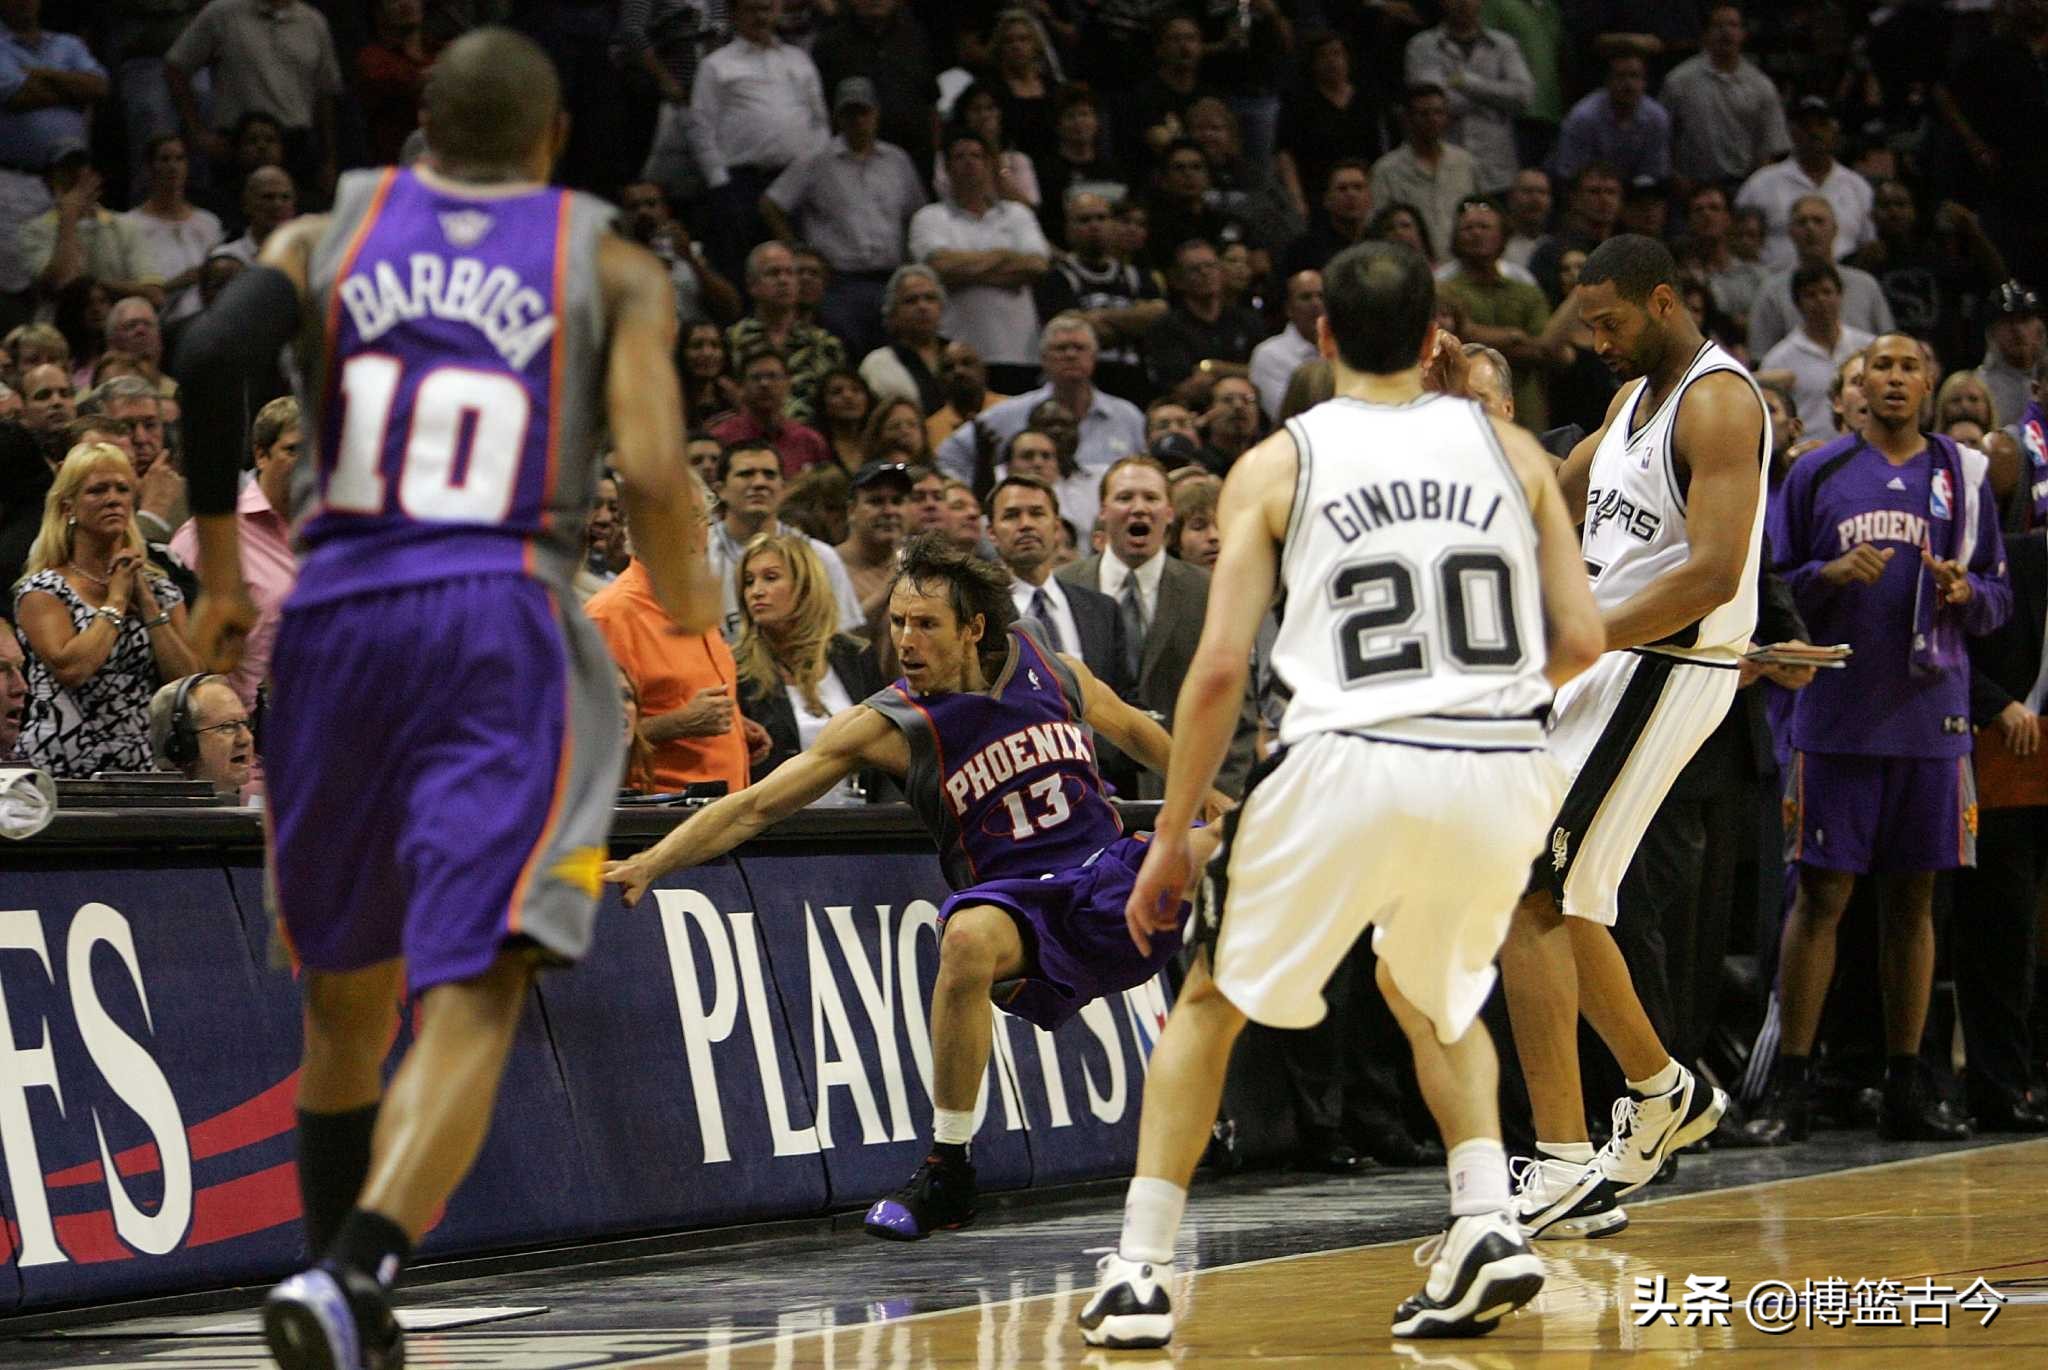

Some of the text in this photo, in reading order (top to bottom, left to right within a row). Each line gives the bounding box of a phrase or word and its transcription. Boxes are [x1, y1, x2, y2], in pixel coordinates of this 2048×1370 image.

[339, 253, 557, 370] BARBOSA
[326, 353, 530, 525] 10
[1322, 479, 1502, 544] GINOBILI
[1328, 547, 1529, 690] 20
[945, 722, 1091, 817] PHOENIX
[1002, 772, 1071, 841] 13
[652, 888, 1128, 1163] PLAYOS
